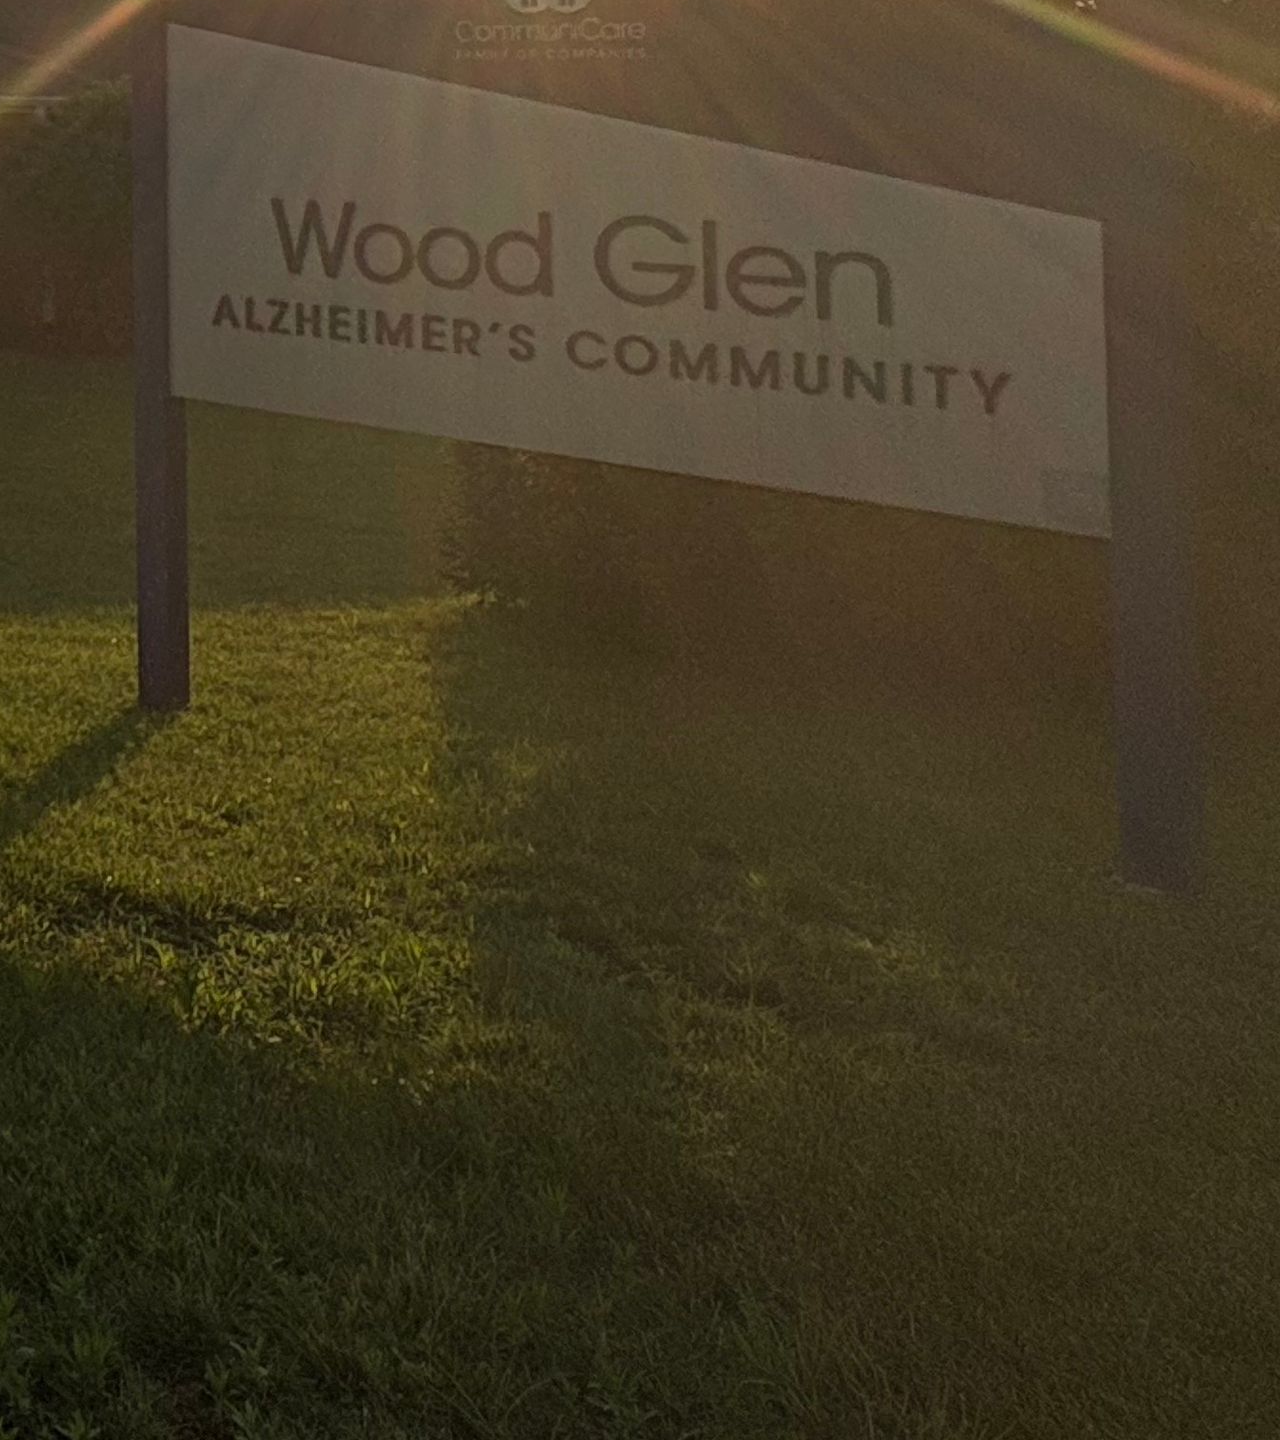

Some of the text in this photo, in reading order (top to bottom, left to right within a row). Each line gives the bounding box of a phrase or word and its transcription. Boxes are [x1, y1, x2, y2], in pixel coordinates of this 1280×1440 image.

[455, 17, 646, 42] CommuniCare
[272, 198, 894, 326] Wood Glen
[212, 295, 1013, 414] ALZHEIMER'S COMMUNITY
